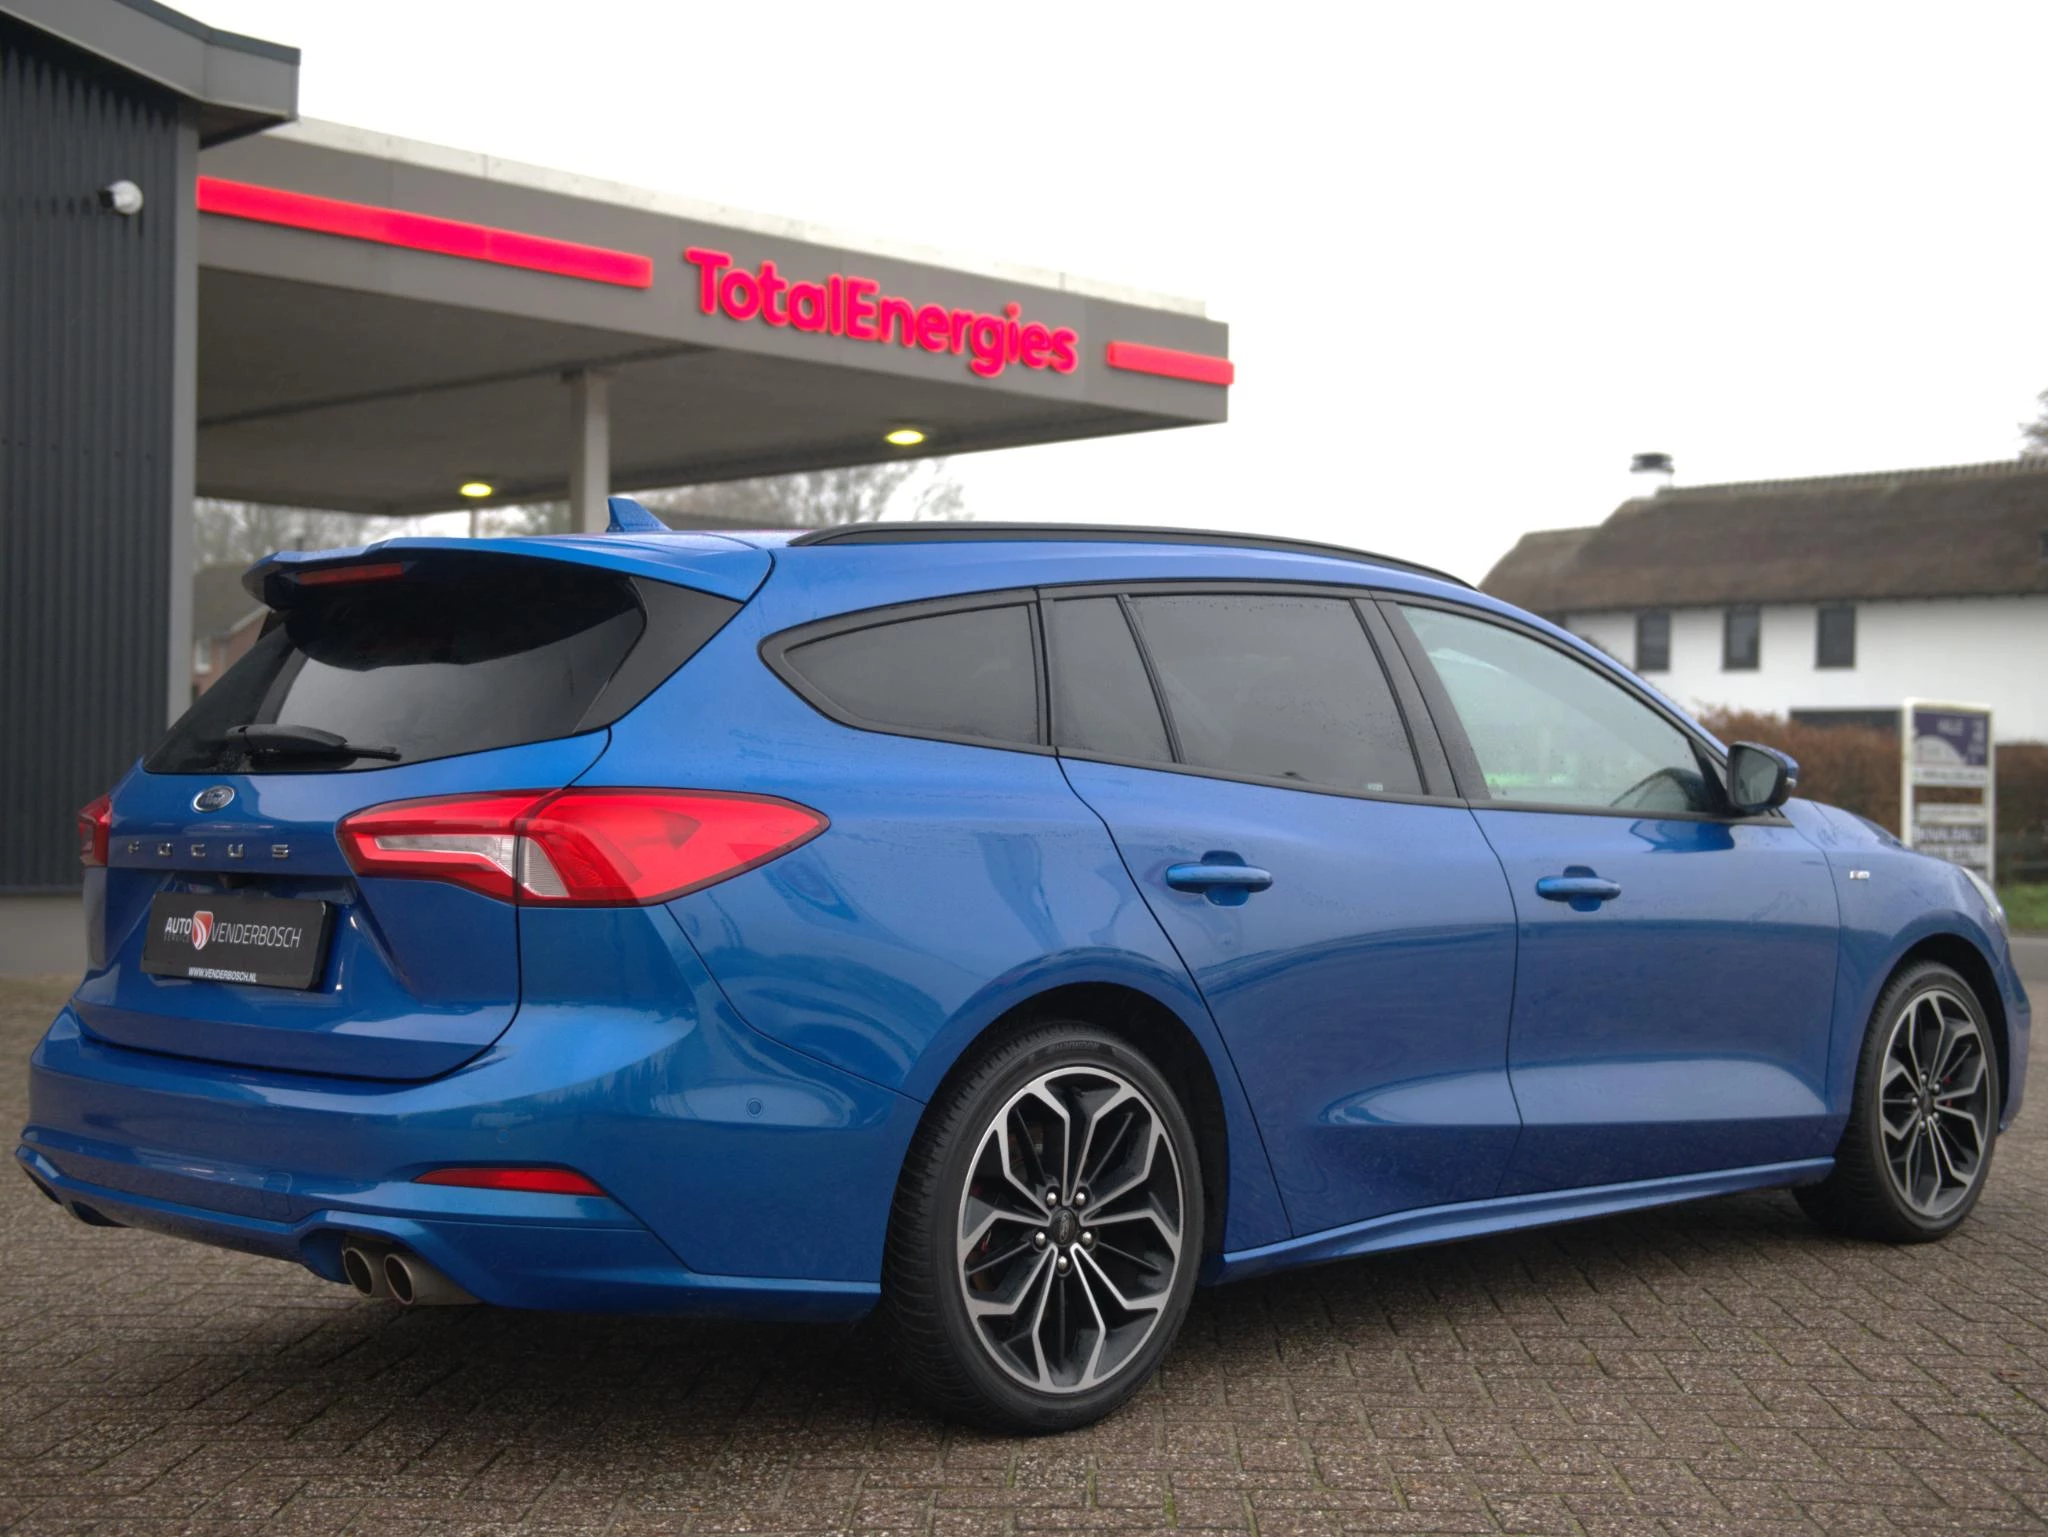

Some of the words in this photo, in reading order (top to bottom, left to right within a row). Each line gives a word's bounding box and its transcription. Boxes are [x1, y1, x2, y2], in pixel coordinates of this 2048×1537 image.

[684, 246, 1079, 378] TotalEnergies
[127, 841, 289, 859] FOCUS
[164, 917, 193, 934] AUTO
[211, 922, 302, 949] VENDERBOSCH
[188, 966, 257, 984] WWW.VENDERBOSCH.NL
